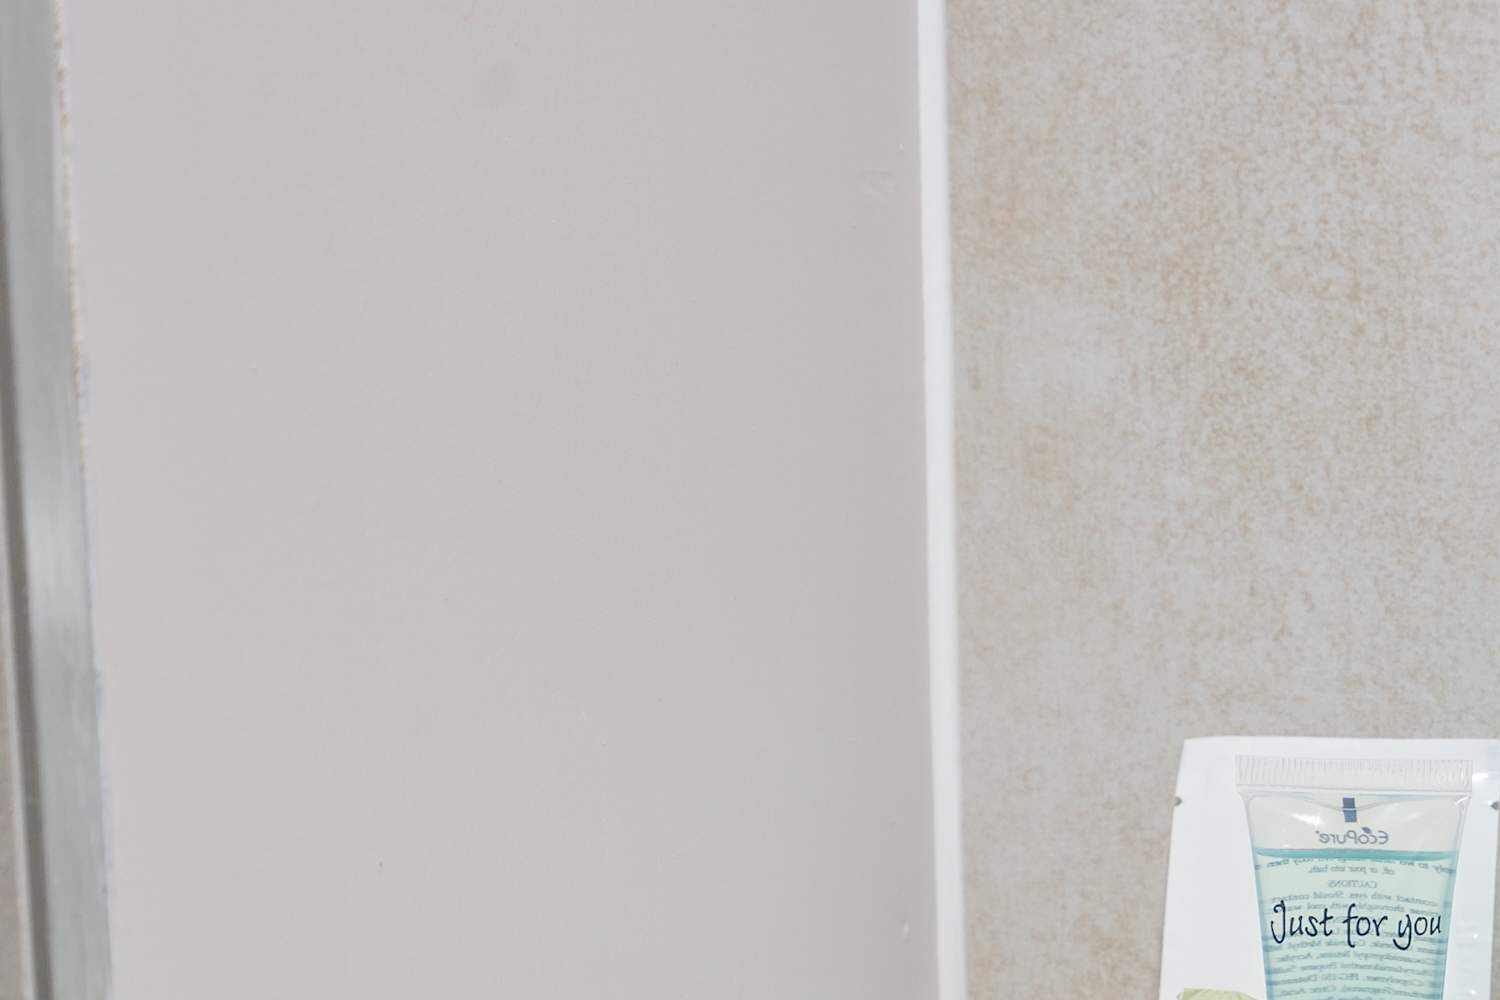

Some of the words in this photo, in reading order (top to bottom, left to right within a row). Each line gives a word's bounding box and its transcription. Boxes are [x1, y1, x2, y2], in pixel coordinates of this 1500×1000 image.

[1271, 900, 1334, 945] Just
[1342, 902, 1389, 949] for
[1392, 913, 1443, 951] you
